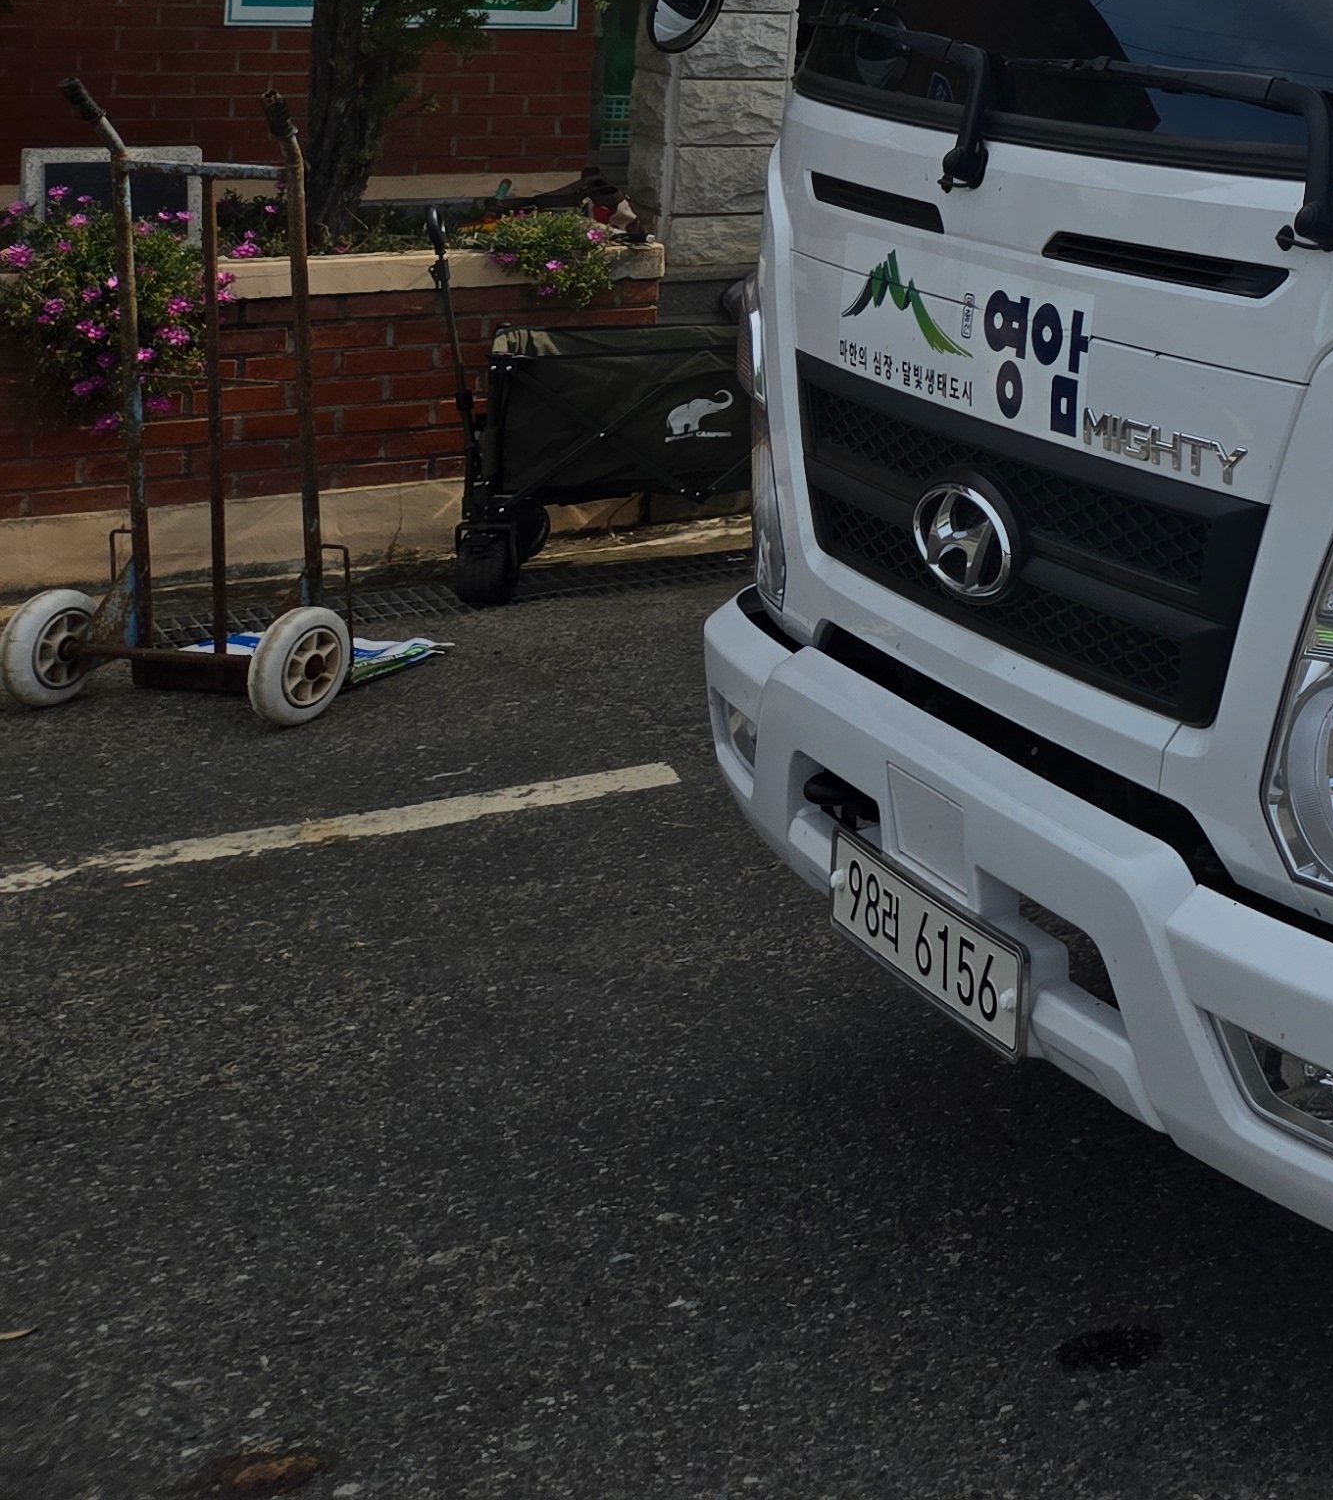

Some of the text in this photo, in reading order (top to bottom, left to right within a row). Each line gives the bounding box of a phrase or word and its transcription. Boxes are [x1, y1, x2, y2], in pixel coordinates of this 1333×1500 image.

[839, 339, 867, 371] 마한의
[984, 289, 1090, 438] 영암
[1083, 406, 1249, 485] MIGHTY
[848, 859, 998, 1022] 98러 6156
